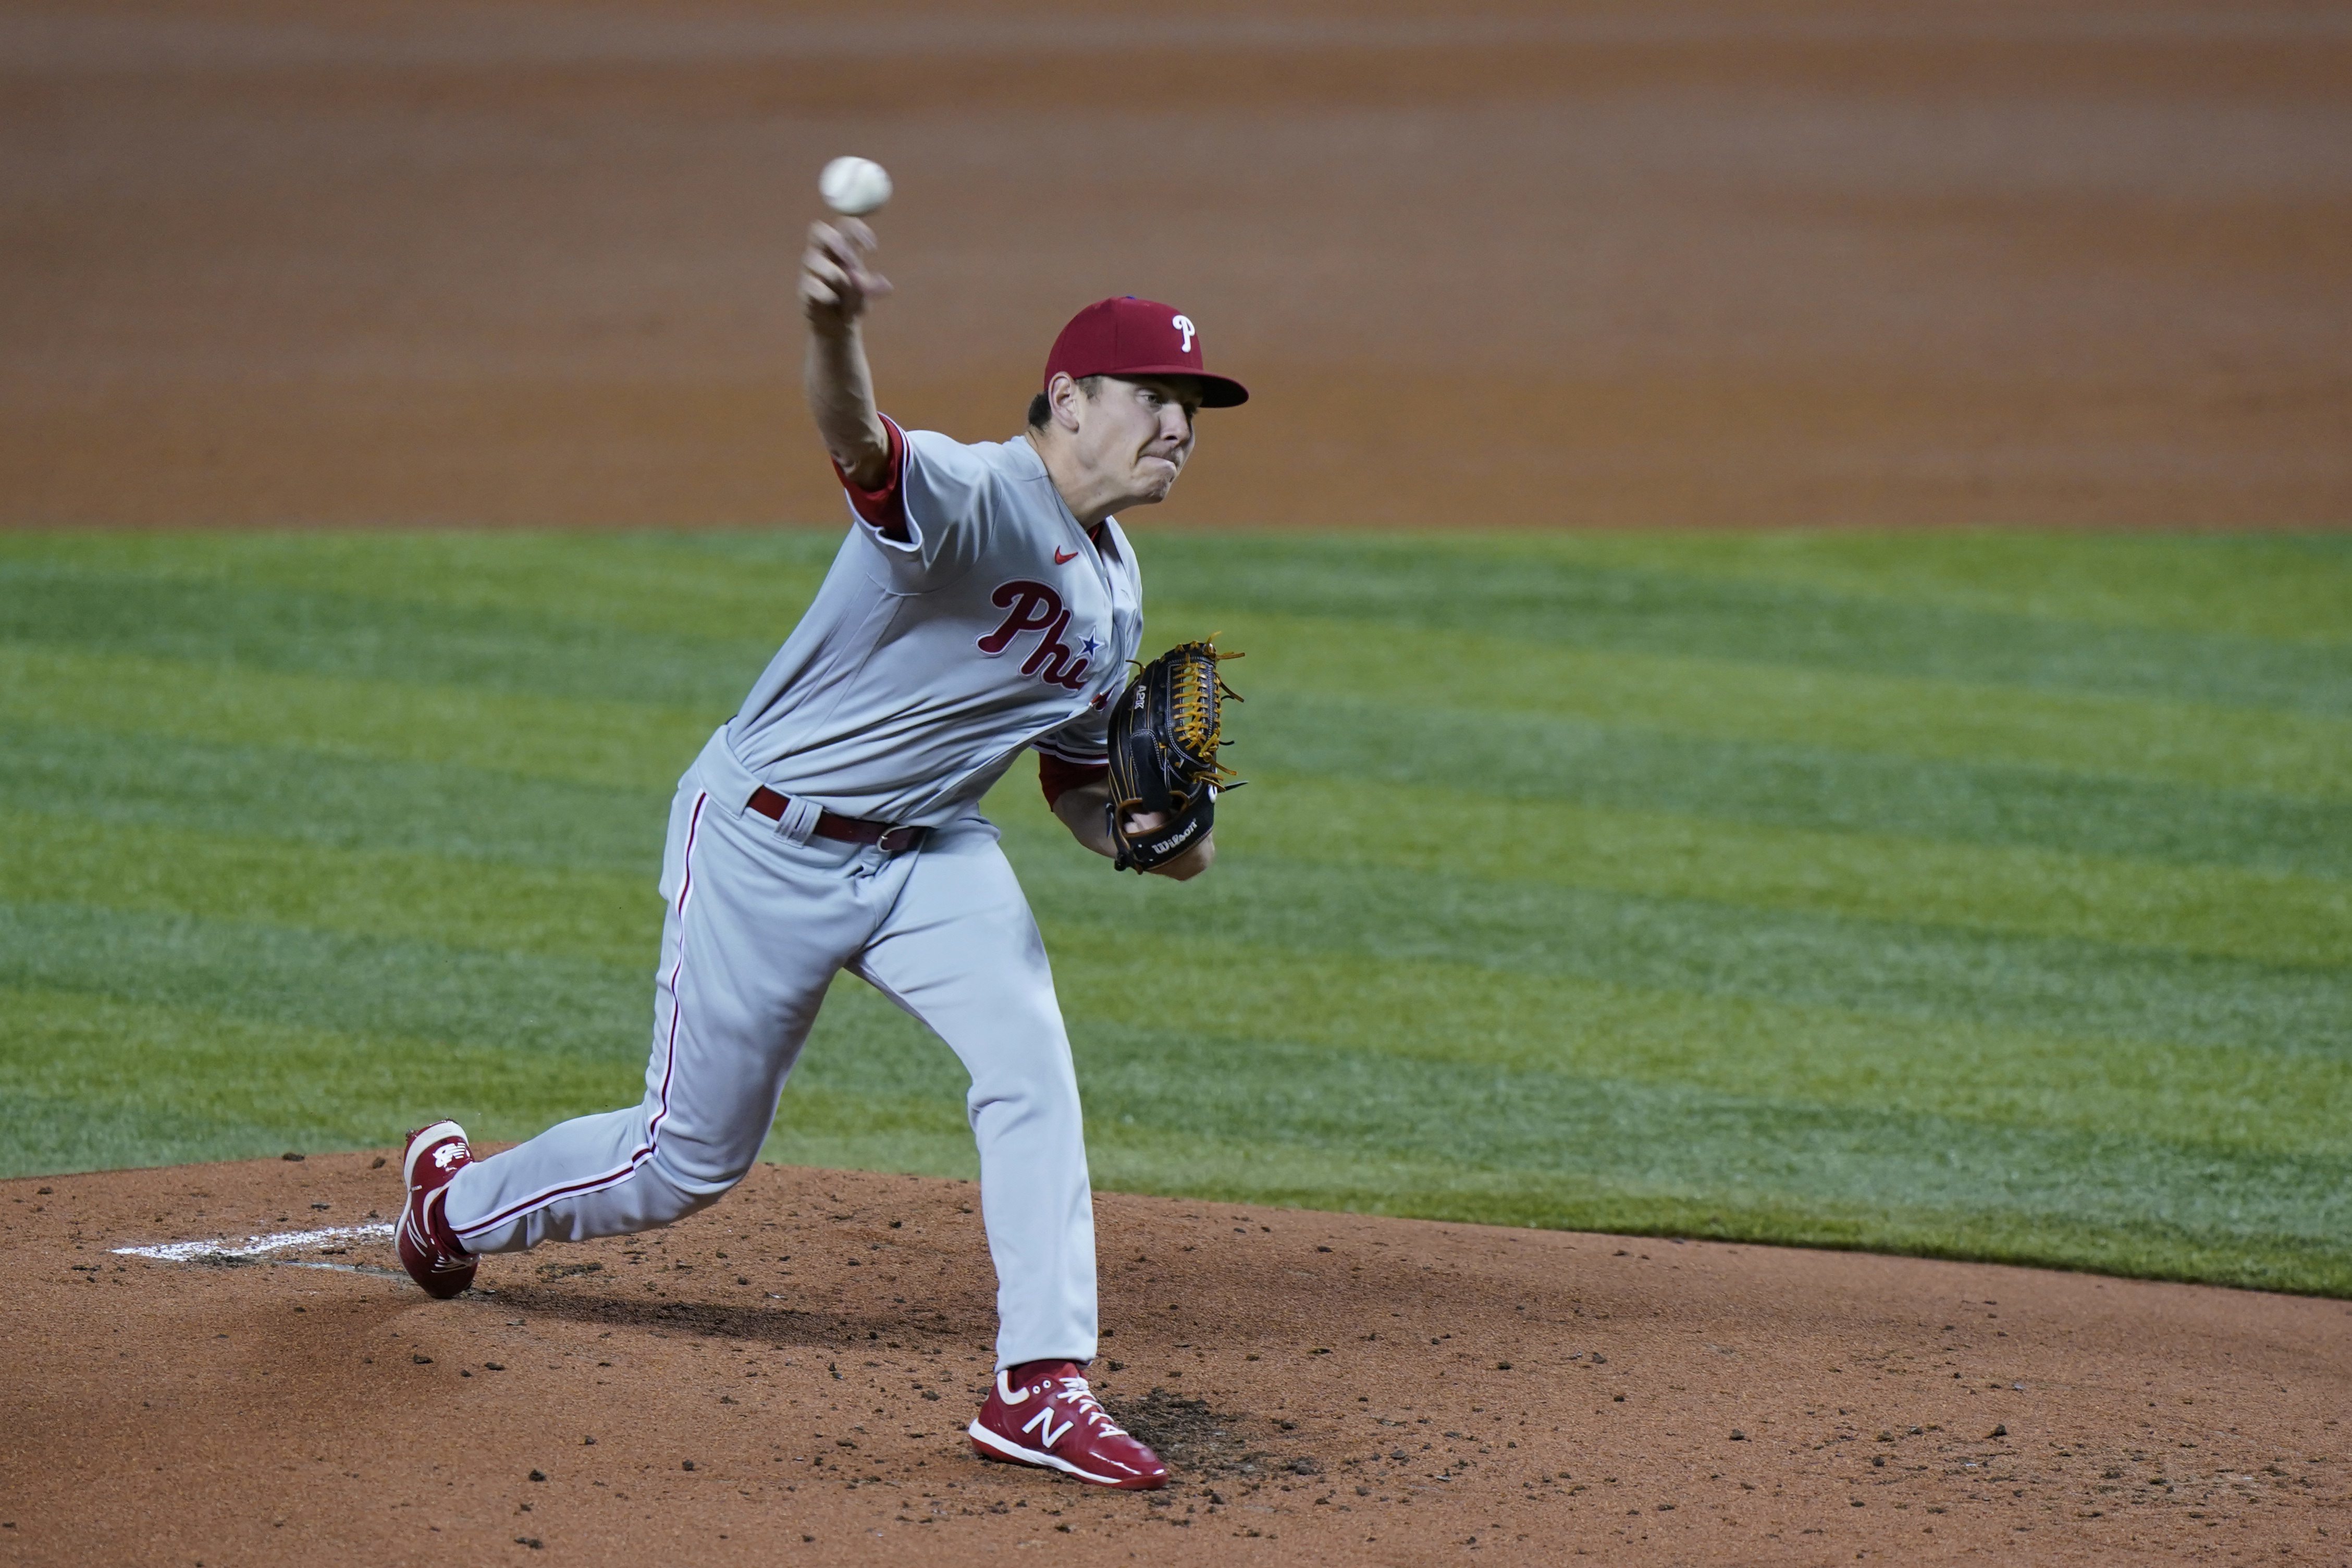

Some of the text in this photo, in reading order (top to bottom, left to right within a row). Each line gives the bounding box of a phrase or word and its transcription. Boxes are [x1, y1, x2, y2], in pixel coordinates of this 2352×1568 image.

[1172, 315, 1195, 353] P
[976, 577, 1105, 693] Phi
[1134, 685, 1147, 710] A2K
[1151, 821, 1198, 854] Wilson
[1021, 1406, 1074, 1448] N
